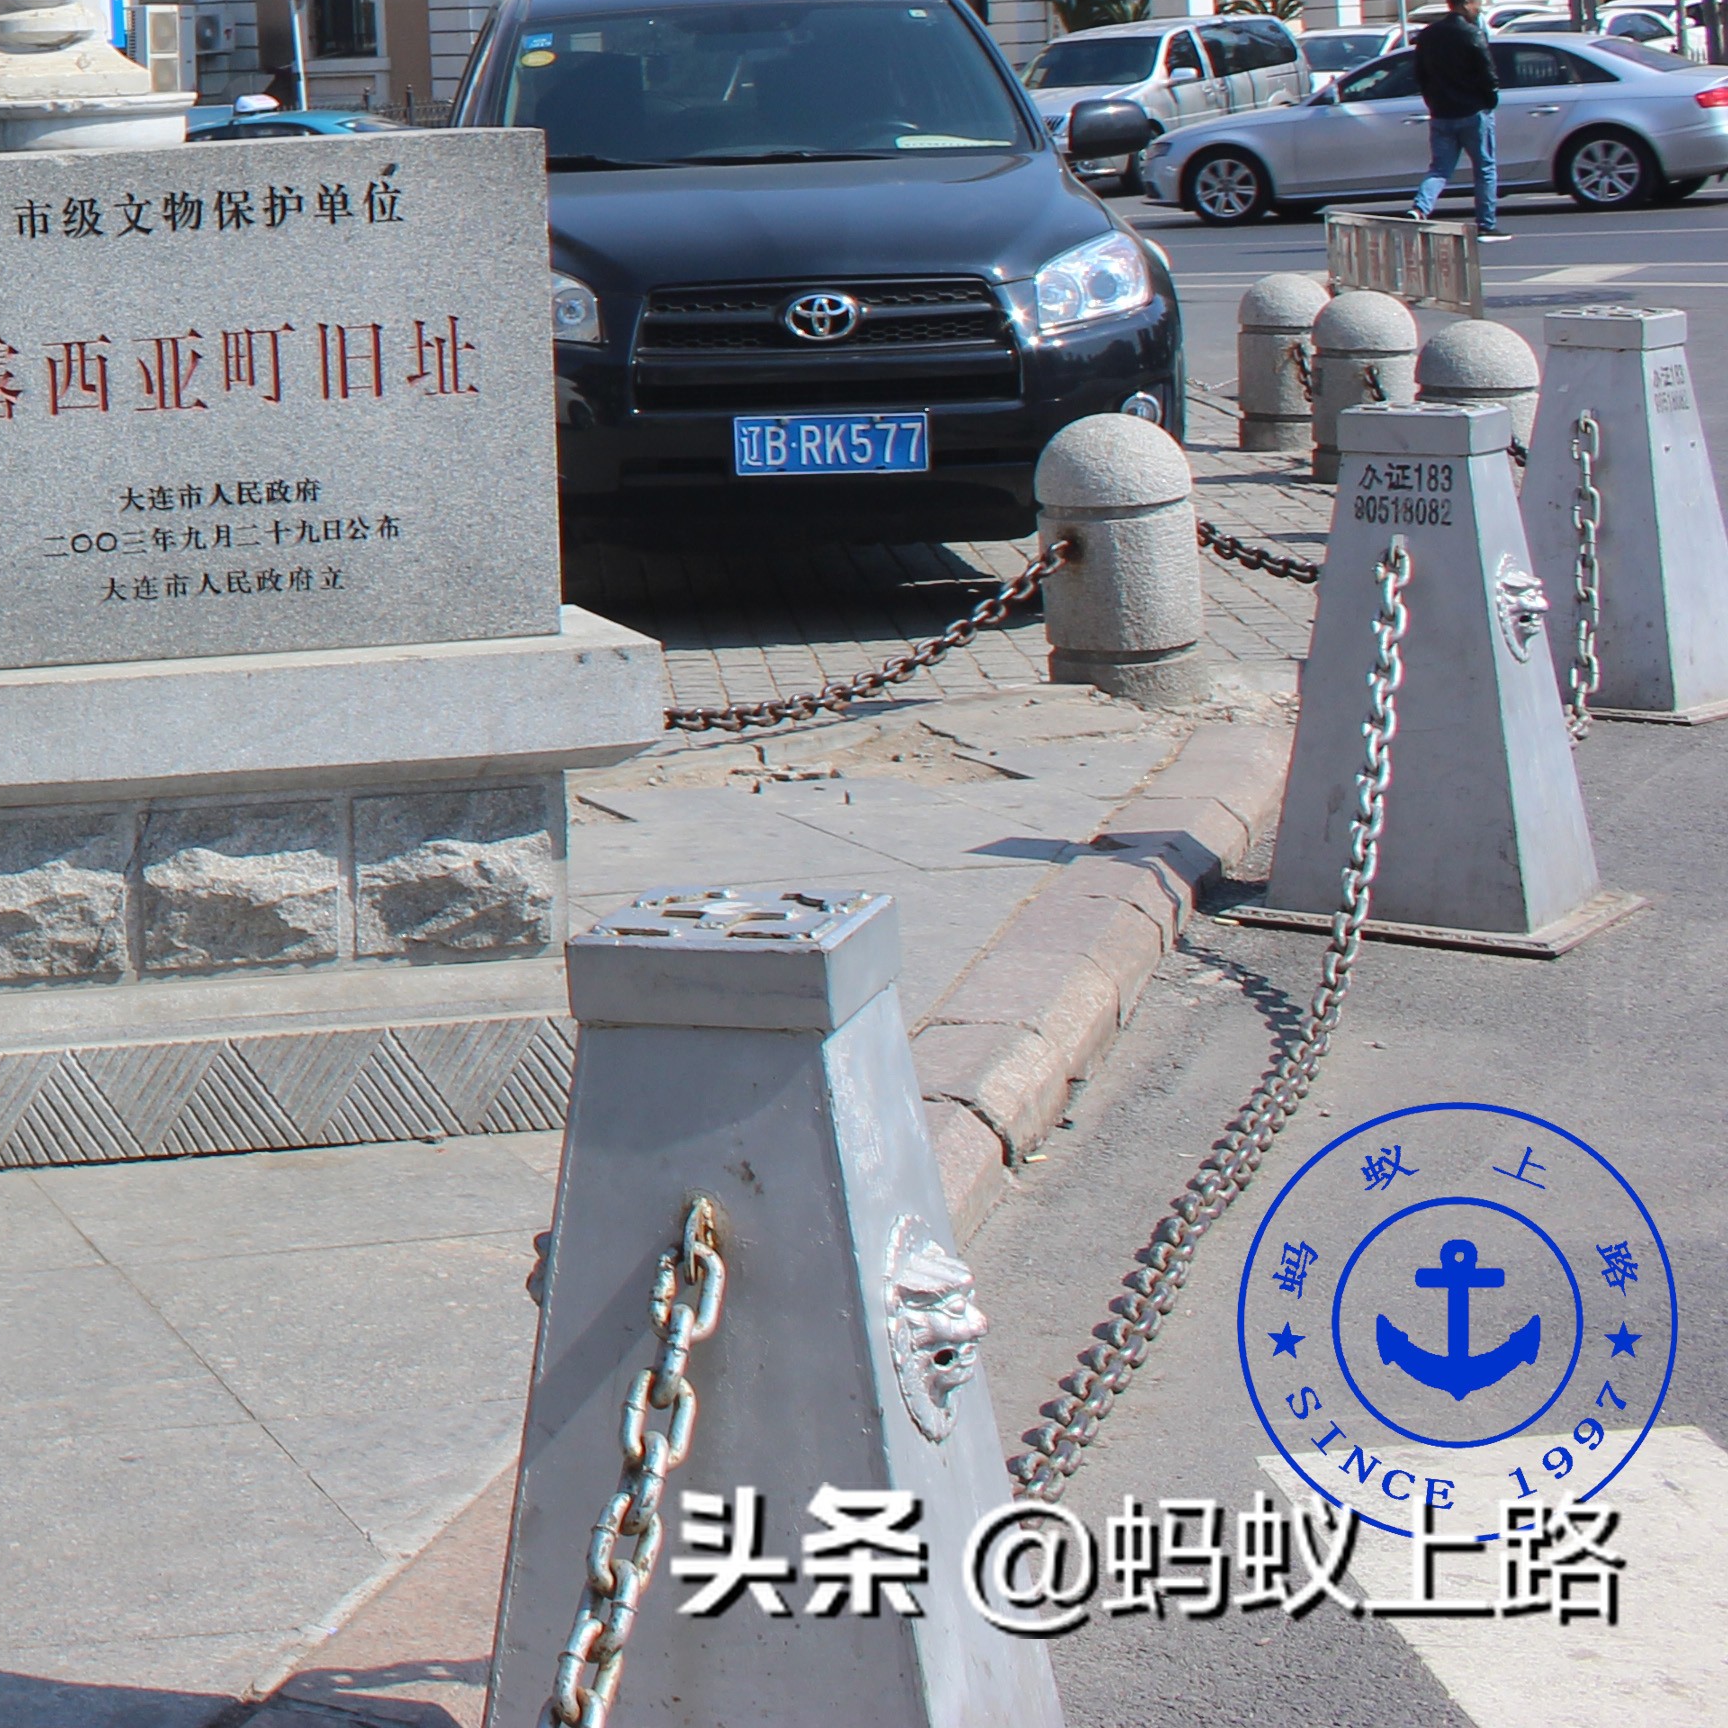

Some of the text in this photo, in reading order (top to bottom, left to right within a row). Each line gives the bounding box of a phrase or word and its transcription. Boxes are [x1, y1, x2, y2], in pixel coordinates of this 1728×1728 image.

[14, 179, 404, 240] 市级文物保护单位
[119, 478, 322, 513] 大连市人民政府
[1354, 495, 1452, 526] 80518082
[100, 566, 345, 602] 大连市人民政府立
